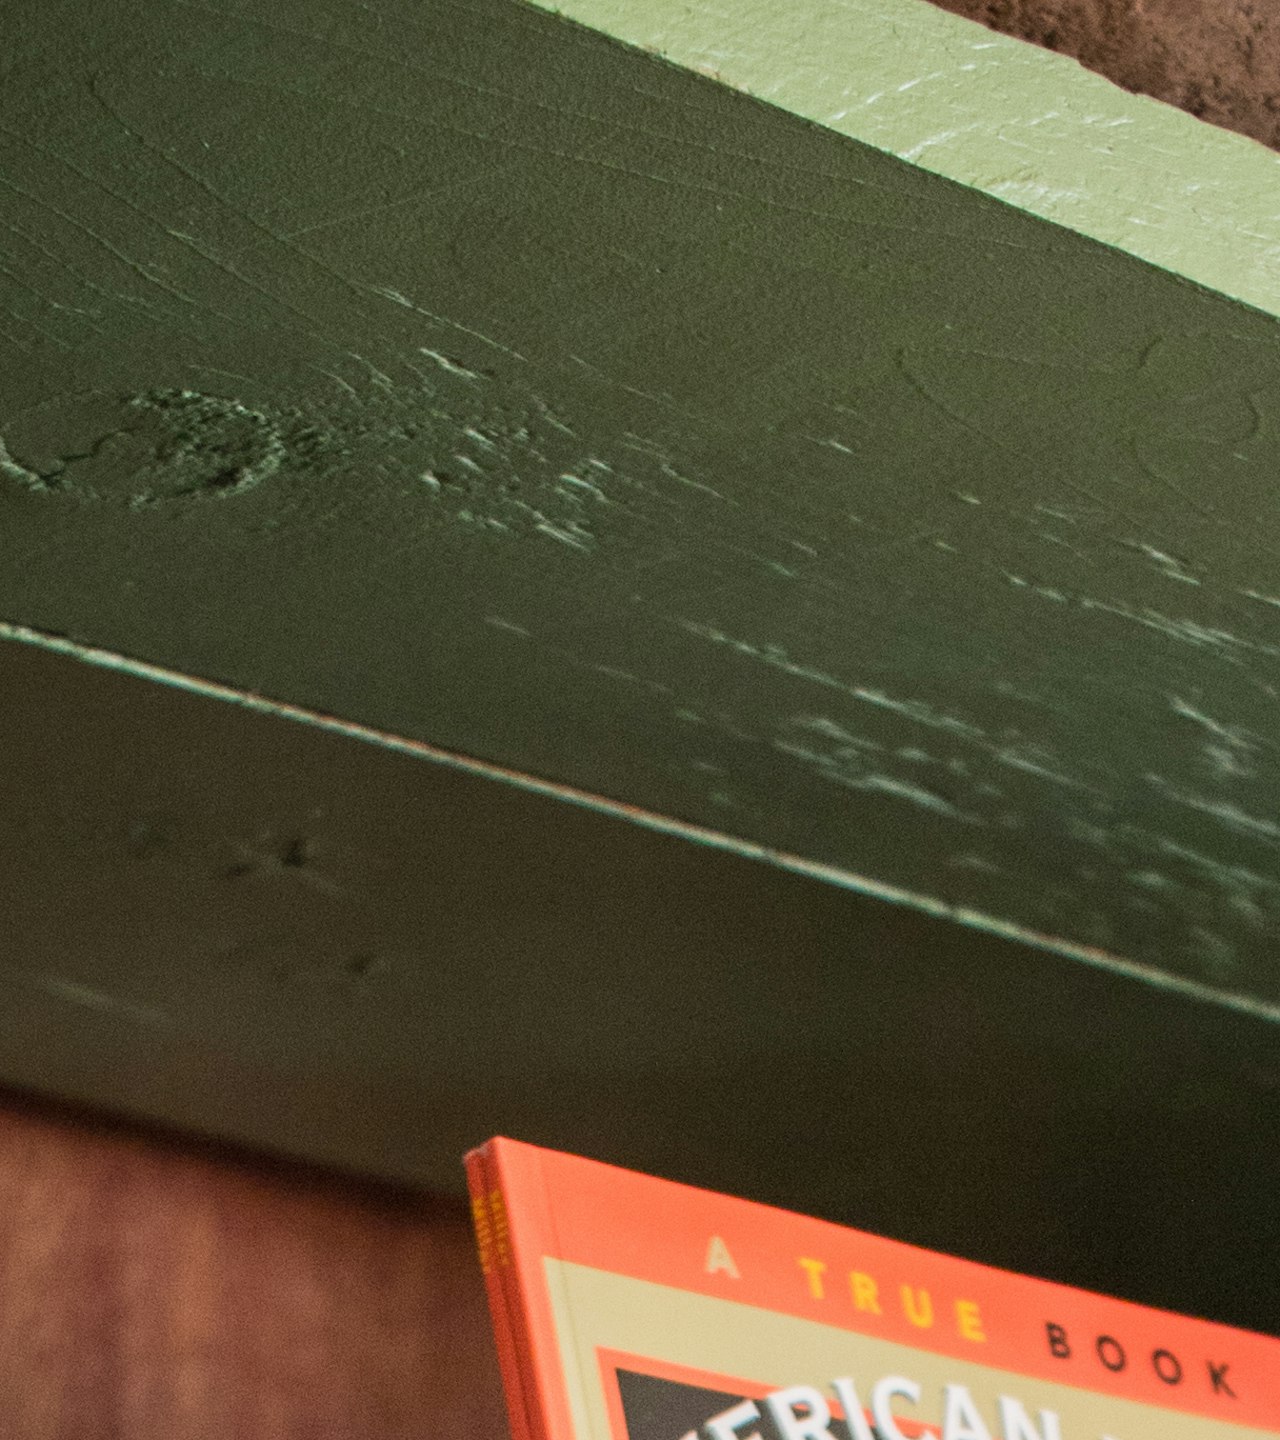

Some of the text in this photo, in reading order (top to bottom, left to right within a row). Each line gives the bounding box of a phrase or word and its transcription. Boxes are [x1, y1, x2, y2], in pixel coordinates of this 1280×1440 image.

[705, 1237, 1240, 1399] A TRUE BOOK
